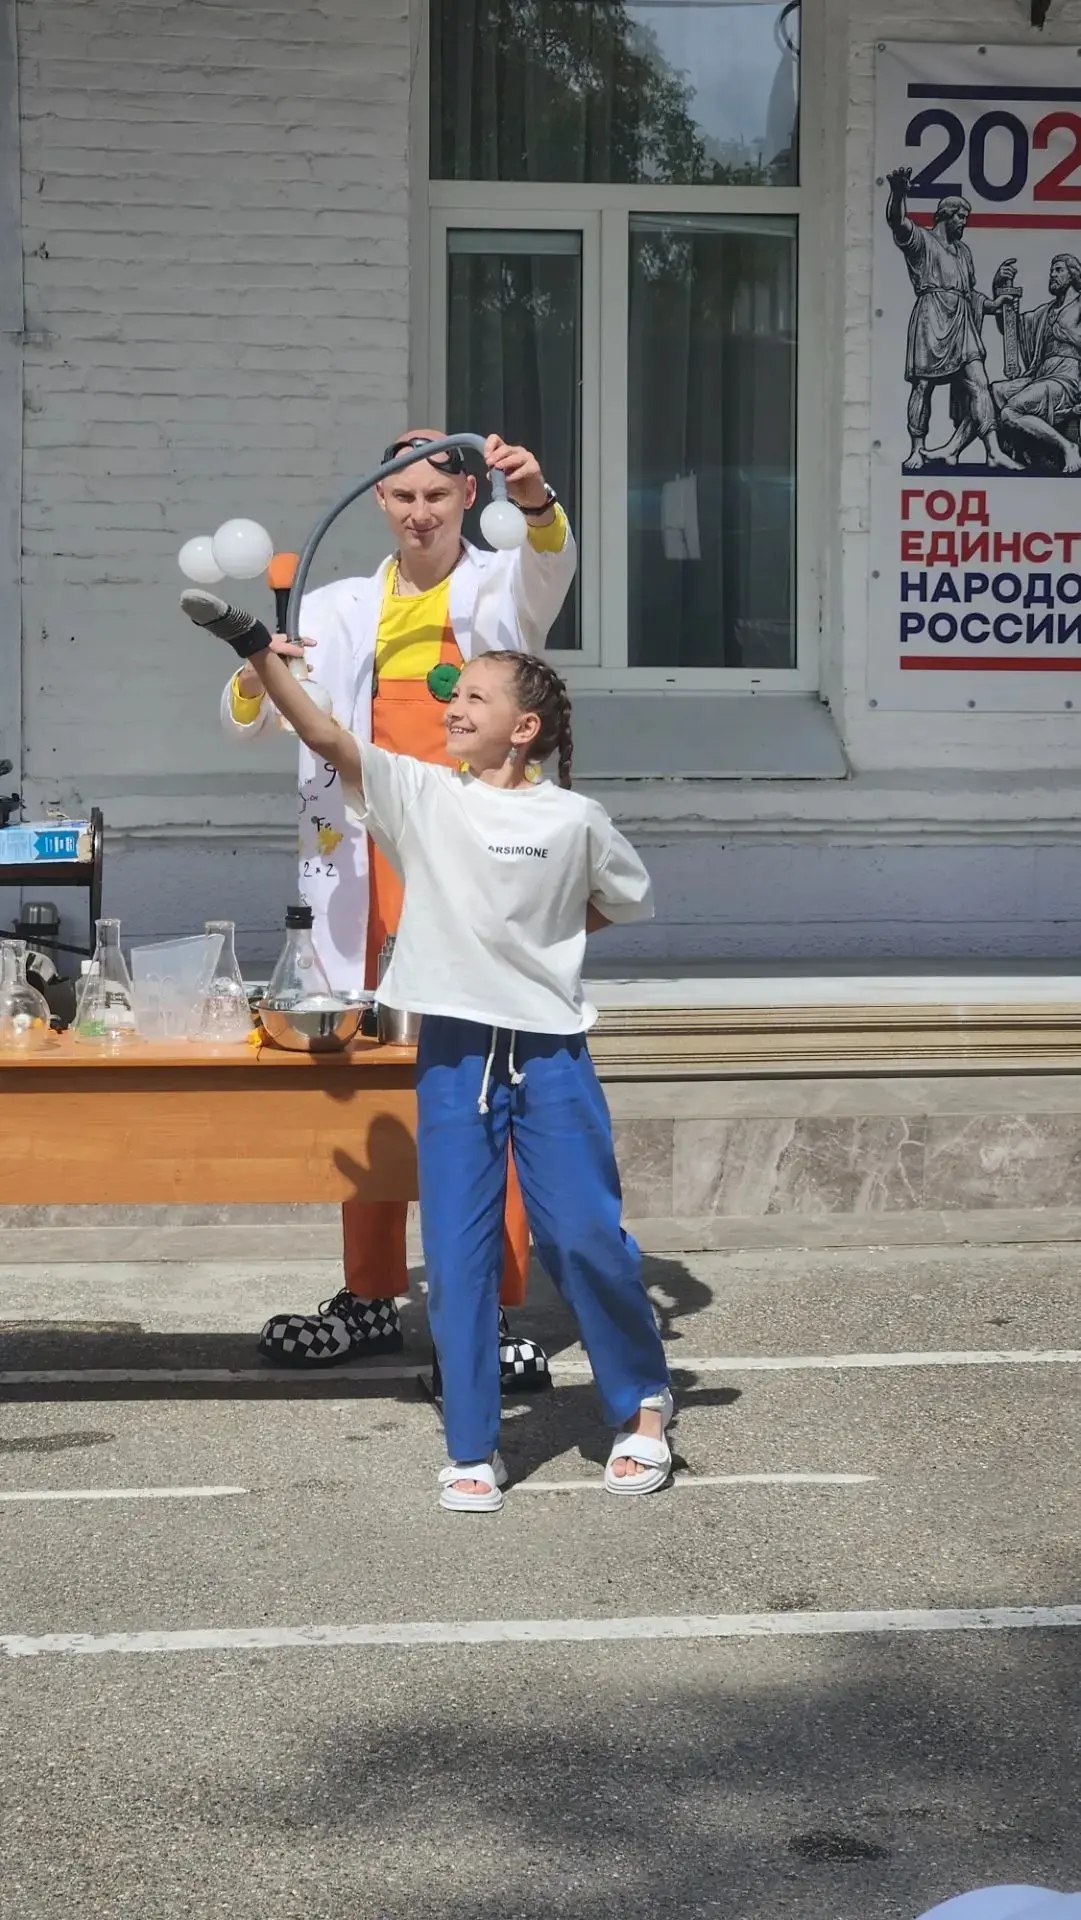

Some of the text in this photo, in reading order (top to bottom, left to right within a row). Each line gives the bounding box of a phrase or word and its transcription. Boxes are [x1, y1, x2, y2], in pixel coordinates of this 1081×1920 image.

[905, 108, 1081, 202] 202
[901, 489, 990, 527] ГОД
[901, 530, 1081, 567] ЕДИНСТ
[900, 571, 1081, 609] НАРОДО
[900, 612, 1081, 644] РОССИИ
